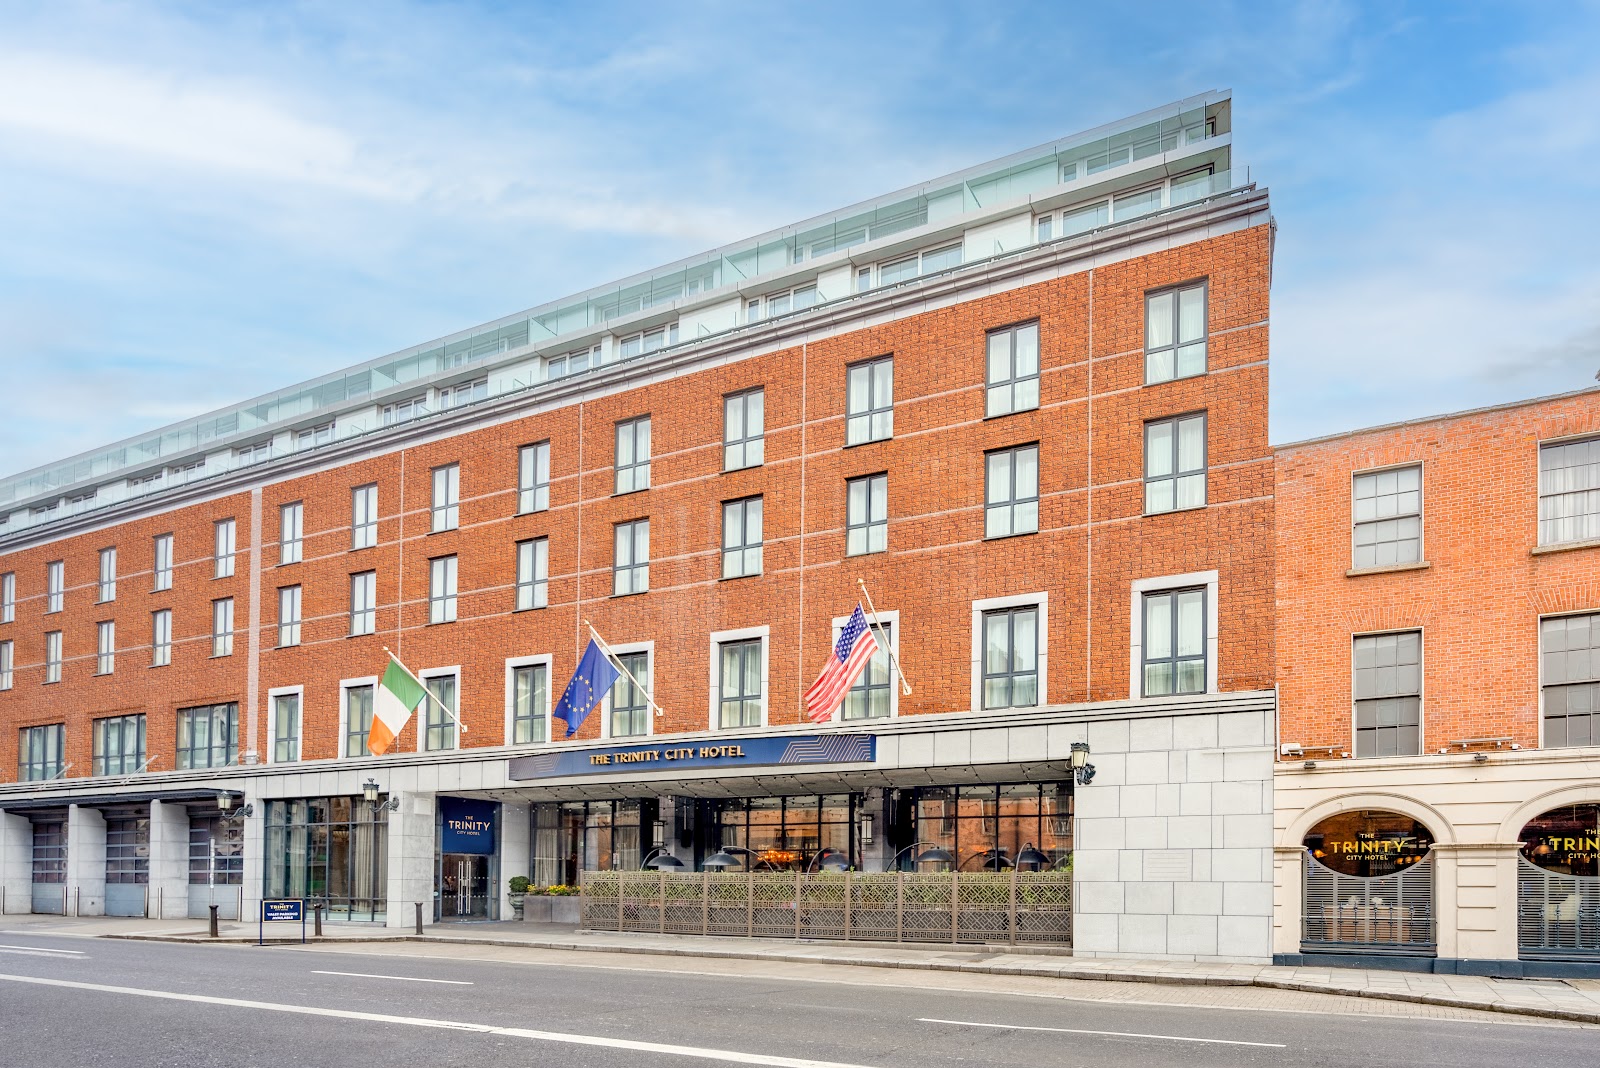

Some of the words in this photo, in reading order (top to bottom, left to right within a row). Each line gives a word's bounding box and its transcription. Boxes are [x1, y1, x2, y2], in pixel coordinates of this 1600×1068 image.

[589, 754, 611, 765] THE
[614, 750, 661, 764] TRINITY
[664, 748, 694, 760] CITY
[700, 745, 745, 758] HOTEL
[448, 820, 491, 831] TRINITY
[1330, 840, 1405, 853] TRINITY
